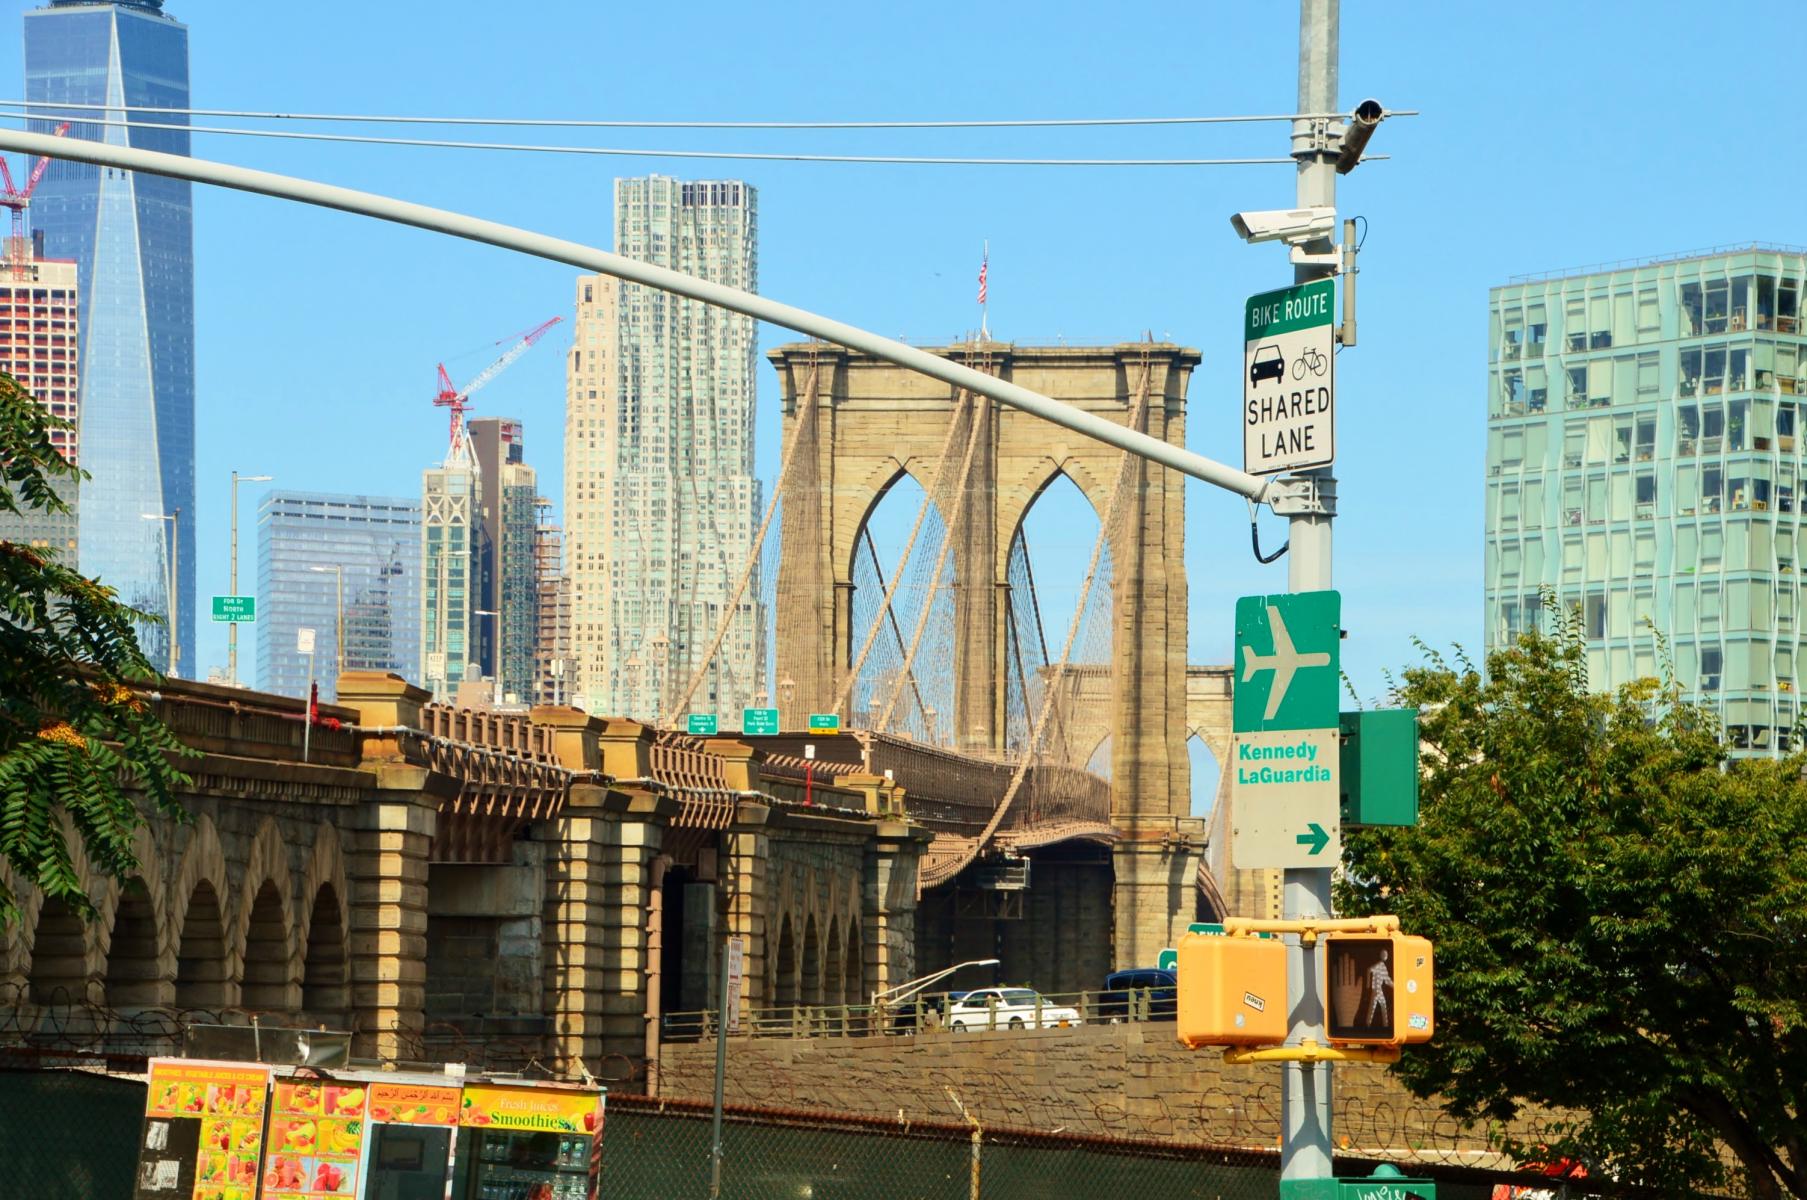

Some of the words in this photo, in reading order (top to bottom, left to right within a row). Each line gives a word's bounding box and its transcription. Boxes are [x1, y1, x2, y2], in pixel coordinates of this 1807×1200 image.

[1252, 303, 1280, 328] BIKE
[1285, 293, 1328, 321] ROUTE
[1248, 387, 1330, 426] SHARED
[1262, 425, 1315, 459] LANE
[1239, 740, 1317, 762] Kennedy
[1238, 765, 1331, 785] LaGuardia
[500, 1097, 528, 1110] Fresh
[490, 1111, 565, 1130] Smoothies
